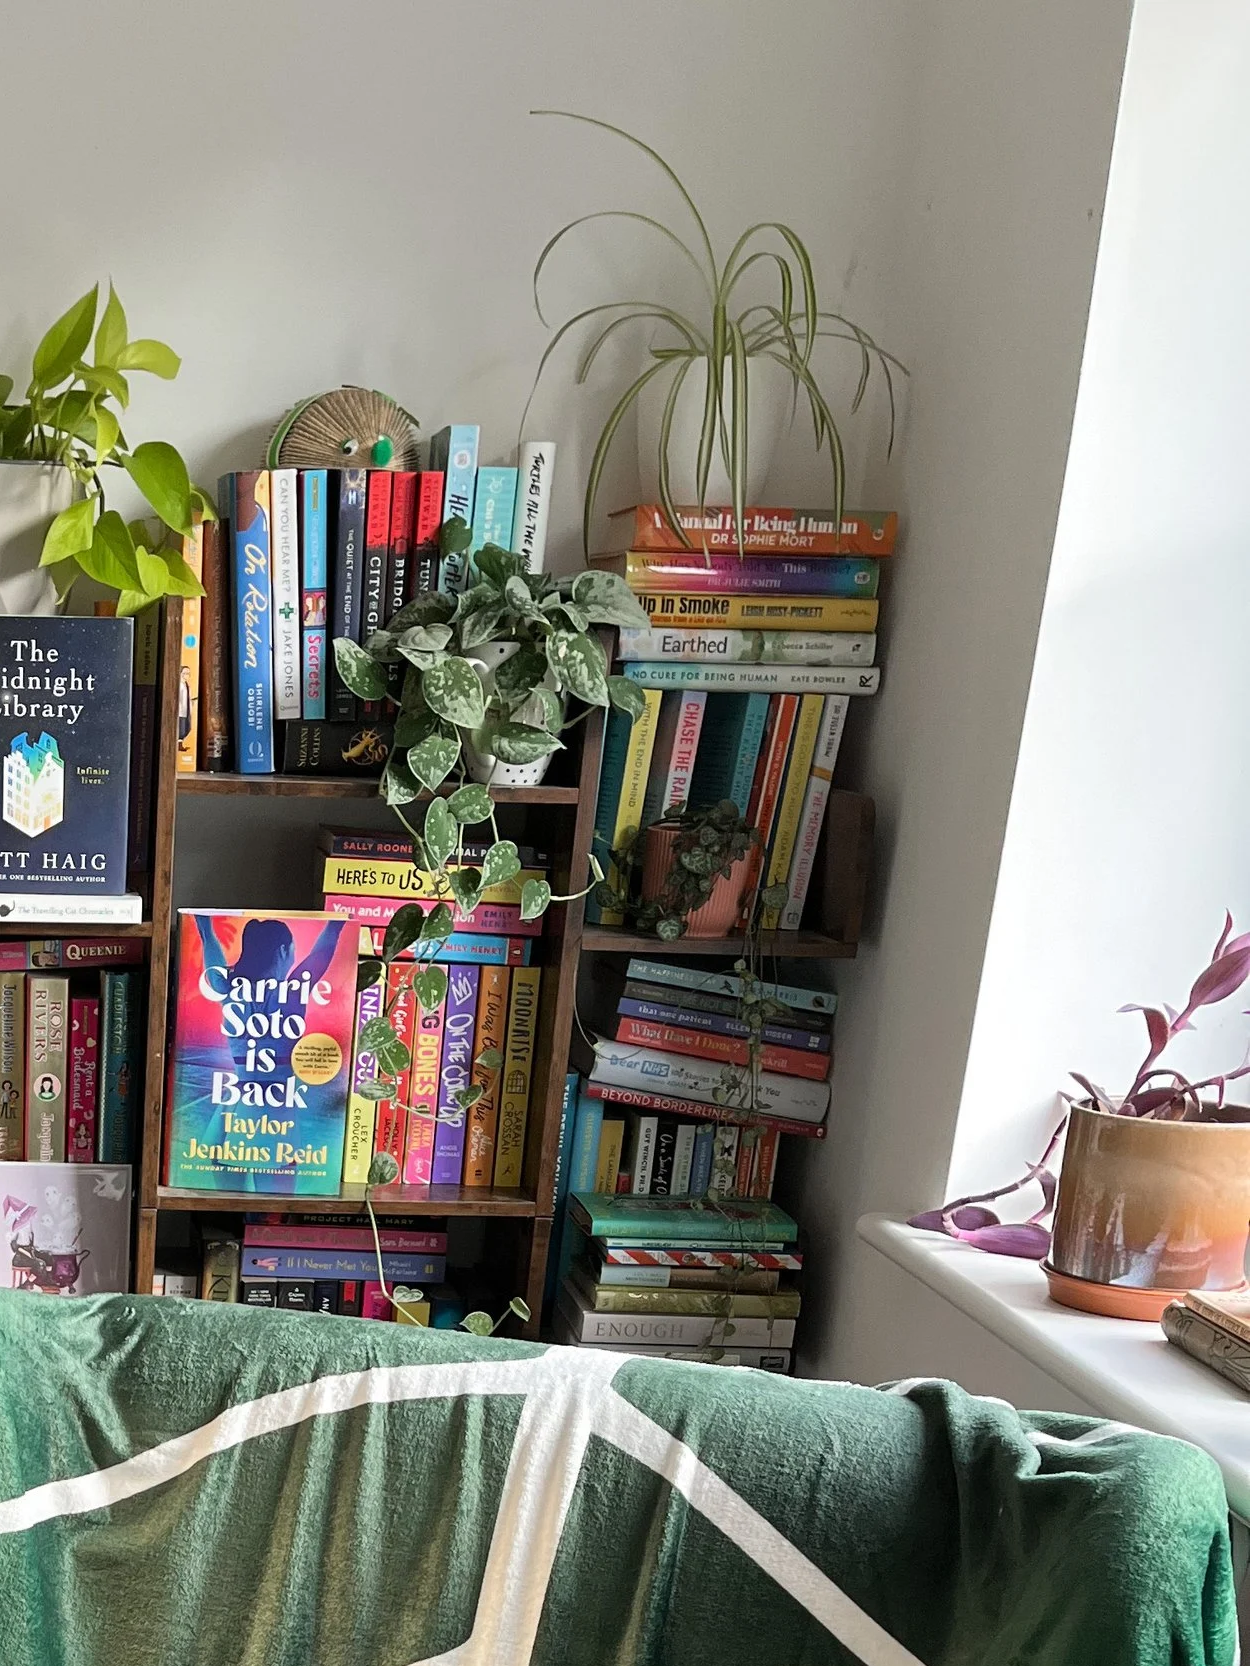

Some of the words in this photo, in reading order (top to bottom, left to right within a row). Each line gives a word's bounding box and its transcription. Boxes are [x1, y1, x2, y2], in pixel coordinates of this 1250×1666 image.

[530, 452, 545, 497] TURTLES
[279, 478, 290, 503] CAN
[280, 506, 291, 535] YOU
[527, 498, 539, 521] ALL
[524, 523, 536, 548] THE
[753, 514, 797, 534] Being
[710, 532, 729, 545] DR
[779, 535, 815, 548] MORT
[244, 543, 266, 576] On
[281, 537, 291, 571] HEAR
[345, 542, 355, 572] QUIET
[368, 556, 382, 597] CITY
[782, 562, 807, 574] This
[282, 574, 292, 593] ME?
[751, 578, 782, 589] SMITH
[343, 595, 353, 614] END
[661, 596, 674, 615] in
[678, 597, 730, 616] Smoke
[243, 581, 268, 670] Rotation
[10, 639, 60, 664] The
[283, 628, 293, 658] JAKE
[661, 635, 729, 655] Earthed
[804, 641, 835, 652] Schiller
[307, 634, 324, 700] Secrets
[631, 670, 648, 680] NO
[650, 670, 677, 681] CURE
[680, 671, 700, 681] FOR
[704, 672, 736, 682] BEING
[739, 673, 778, 683] HUMAN
[284, 661, 295, 699] JONES
[247, 687, 256, 729] OBUOBI
[255, 682, 264, 732] SHIRLENE
[680, 702, 700, 745] CHASE
[76, 766, 111, 776] Infinite
[675, 749, 692, 774] THE
[627, 782, 639, 808] MIND
[343, 841, 374, 852] SALLY
[377, 843, 414, 854] ROONE
[42, 851, 108, 871] HAIG
[9, 873, 25, 882] ONE
[26, 873, 74, 883] BESTSELLING
[75, 874, 106, 884] AUTHOR
[336, 866, 377, 886] HERE'S
[380, 871, 396, 886] TO
[333, 903, 355, 918] You
[357, 905, 382, 917] and
[483, 909, 514, 920] EMILY
[66, 943, 127, 962] QUEENIE
[199, 965, 333, 1006] Carrie
[33, 988, 48, 1063] RIVERS
[48, 999, 64, 1053] ROSE
[220, 1002, 307, 1040] Soto
[446, 1012, 475, 1037] ON
[481, 1001, 501, 1032] Was
[510, 981, 535, 1062] MOONRISE
[678, 1011, 713, 1026] patient
[629, 1021, 661, 1039] What
[663, 1025, 692, 1046] Have
[765, 1029, 793, 1041] VISSER
[3, 1038, 16, 1073] Wilson
[245, 1039, 276, 1073] is
[447, 1039, 470, 1063] THE
[84, 1060, 97, 1088] Rent
[413, 1033, 442, 1096] BONES
[609, 1054, 640, 1070] Dear
[642, 1061, 669, 1077] NHS
[72, 1046, 85, 1110] Bridesmaid
[211, 1071, 308, 1109] Back
[473, 1095, 495, 1122] This
[600, 1087, 652, 1106] BEYOND
[652, 1098, 730, 1121] BORDERLINE
[221, 1112, 295, 1139] Taylor
[350, 1107, 362, 1162] CROUCHER
[360, 1124, 369, 1144] LEX
[500, 1100, 515, 1156] CROSSAN
[512, 1109, 525, 1148] SARAH
[642, 1127, 653, 1144] GUY
[182, 1138, 271, 1165] Jenkins
[275, 1142, 328, 1166] Reid
[196, 1165, 225, 1173] SUNDAY
[302, 1215, 352, 1223] PROJECT
[385, 1218, 415, 1226] MARY
[398, 1237, 427, 1248] Barnard
[302, 1257, 334, 1271] Never
[335, 1260, 357, 1272] Met
[359, 1260, 379, 1274] You
[593, 1320, 684, 1340] ENOUGH
